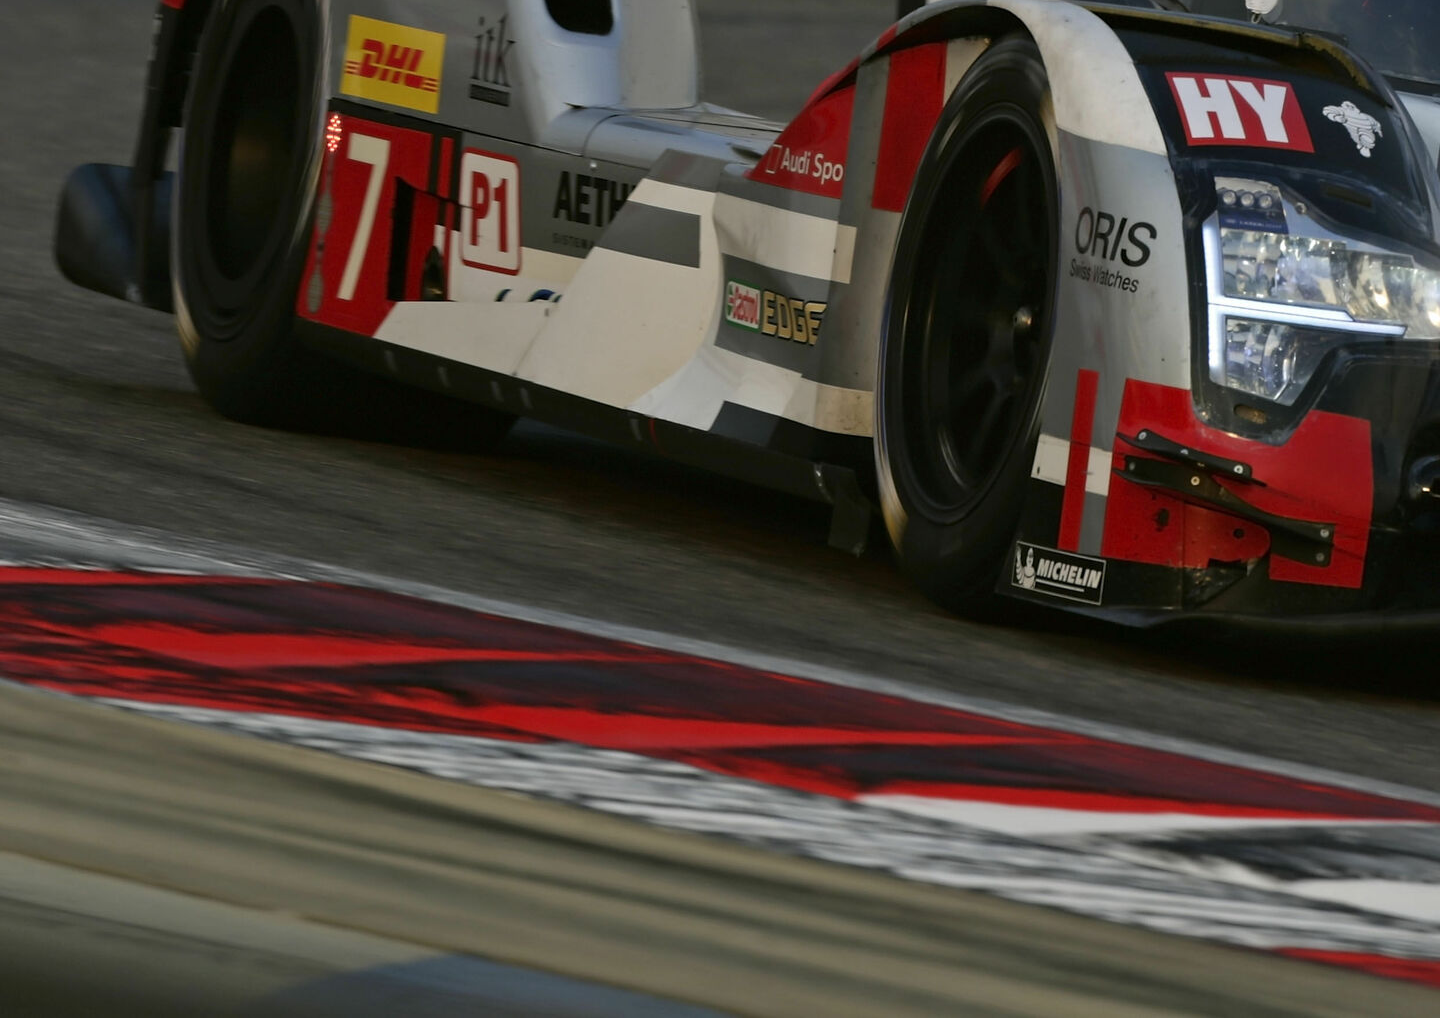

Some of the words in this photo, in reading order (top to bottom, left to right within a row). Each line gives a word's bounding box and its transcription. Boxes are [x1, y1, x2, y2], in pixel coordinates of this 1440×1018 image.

[361, 38, 425, 89] DHL
[1172, 77, 1290, 144] HY
[780, 147, 811, 175] Audi
[337, 132, 391, 301] 7
[471, 172, 508, 253] P1
[553, 171, 637, 228] AETH
[1075, 206, 1158, 268] ORIS
[1069, 258, 1092, 282] Swiss
[1092, 264, 1140, 293] Watches
[761, 289, 828, 347] EDGE
[1036, 558, 1102, 589] MICHELIN
